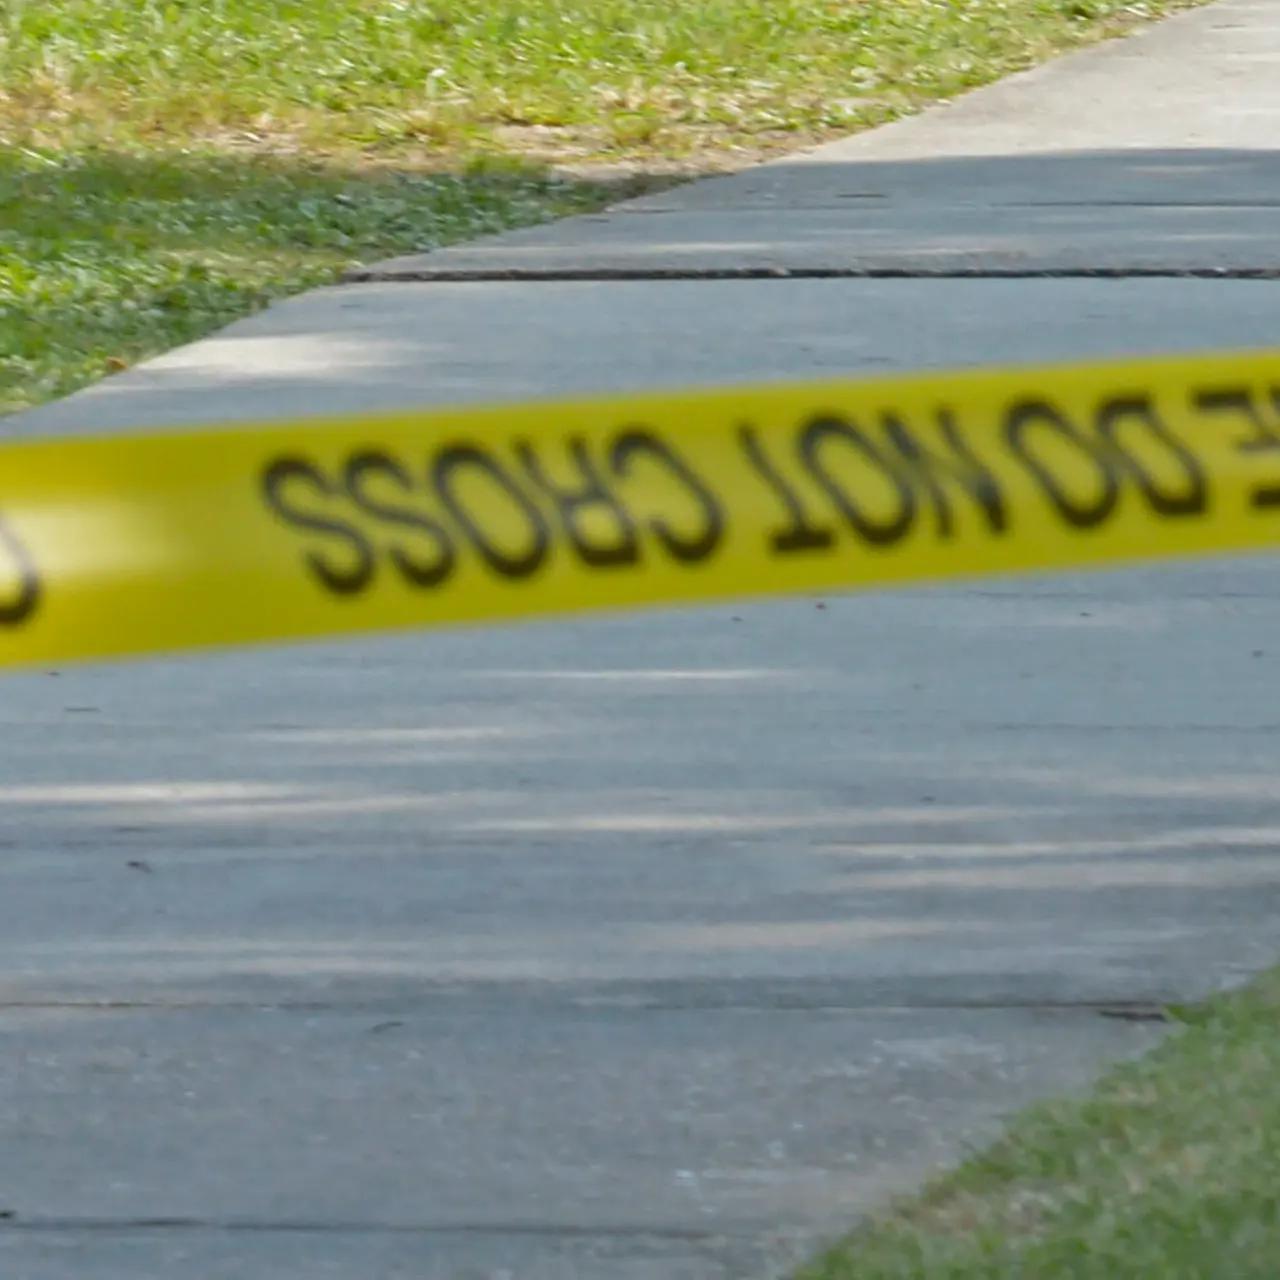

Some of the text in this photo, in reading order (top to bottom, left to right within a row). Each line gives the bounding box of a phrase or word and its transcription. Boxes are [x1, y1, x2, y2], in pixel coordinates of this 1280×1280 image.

[260, 427, 728, 596] CROSS
[738, 405, 1012, 560] NOT
[1001, 390, 1210, 530] DO
